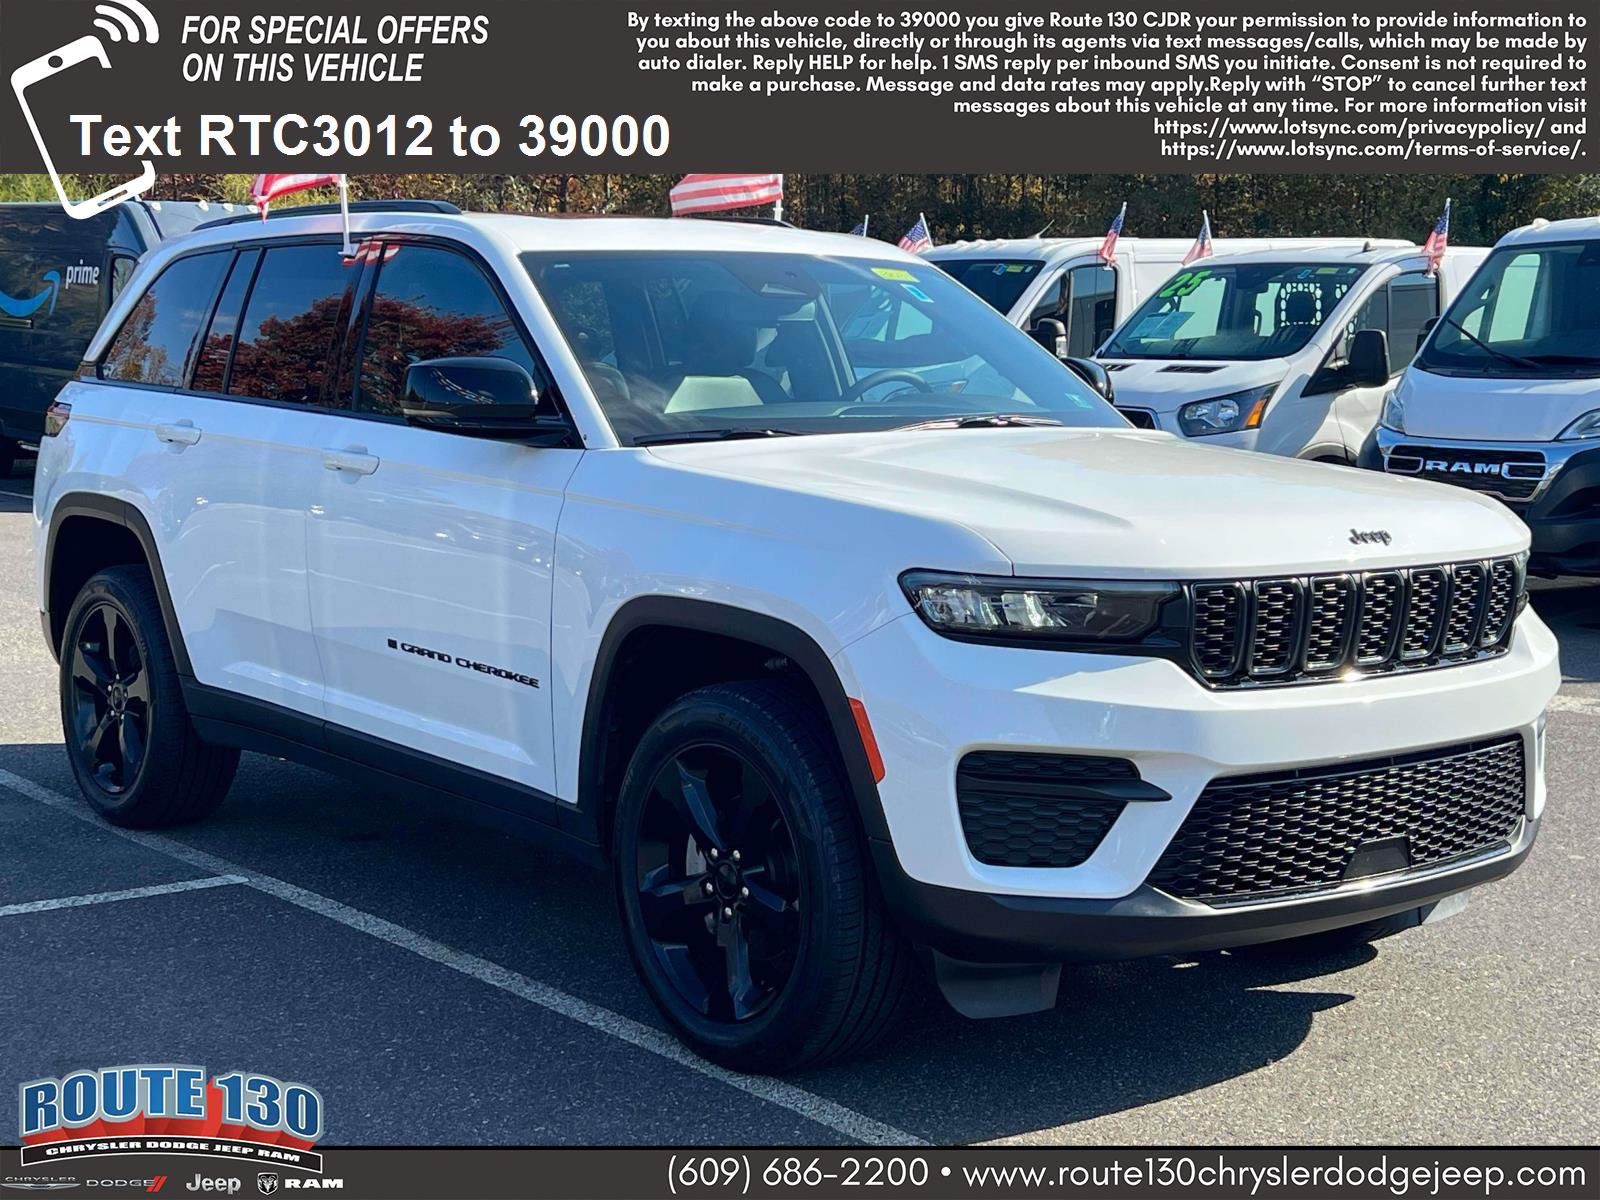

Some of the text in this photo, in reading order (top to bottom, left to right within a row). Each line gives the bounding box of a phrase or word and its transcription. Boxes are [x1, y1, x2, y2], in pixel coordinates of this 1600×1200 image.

[65, 259, 99, 289] prime
[1425, 460, 1500, 474] RAM
[1348, 528, 1392, 546] Jeep
[400, 642, 540, 689] GRAND CHEROKEE
